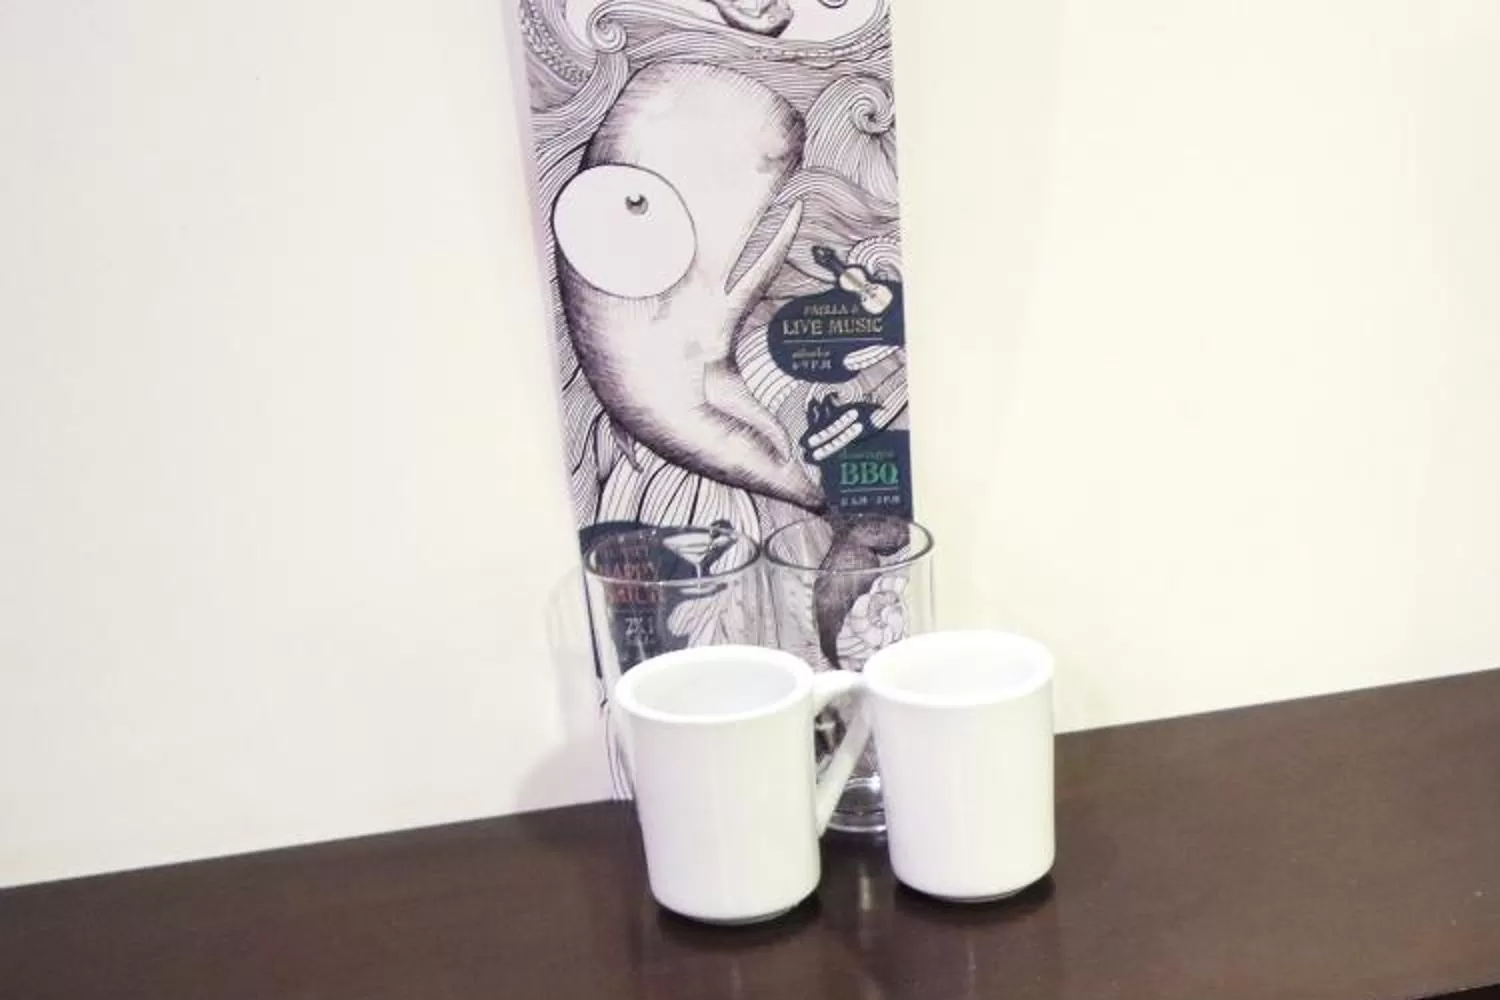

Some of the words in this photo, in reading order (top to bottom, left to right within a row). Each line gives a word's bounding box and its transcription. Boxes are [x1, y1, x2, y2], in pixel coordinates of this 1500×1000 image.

[783, 319, 824, 336] LIVE
[828, 317, 883, 335] MUSIC
[840, 462, 899, 485] BBQ
